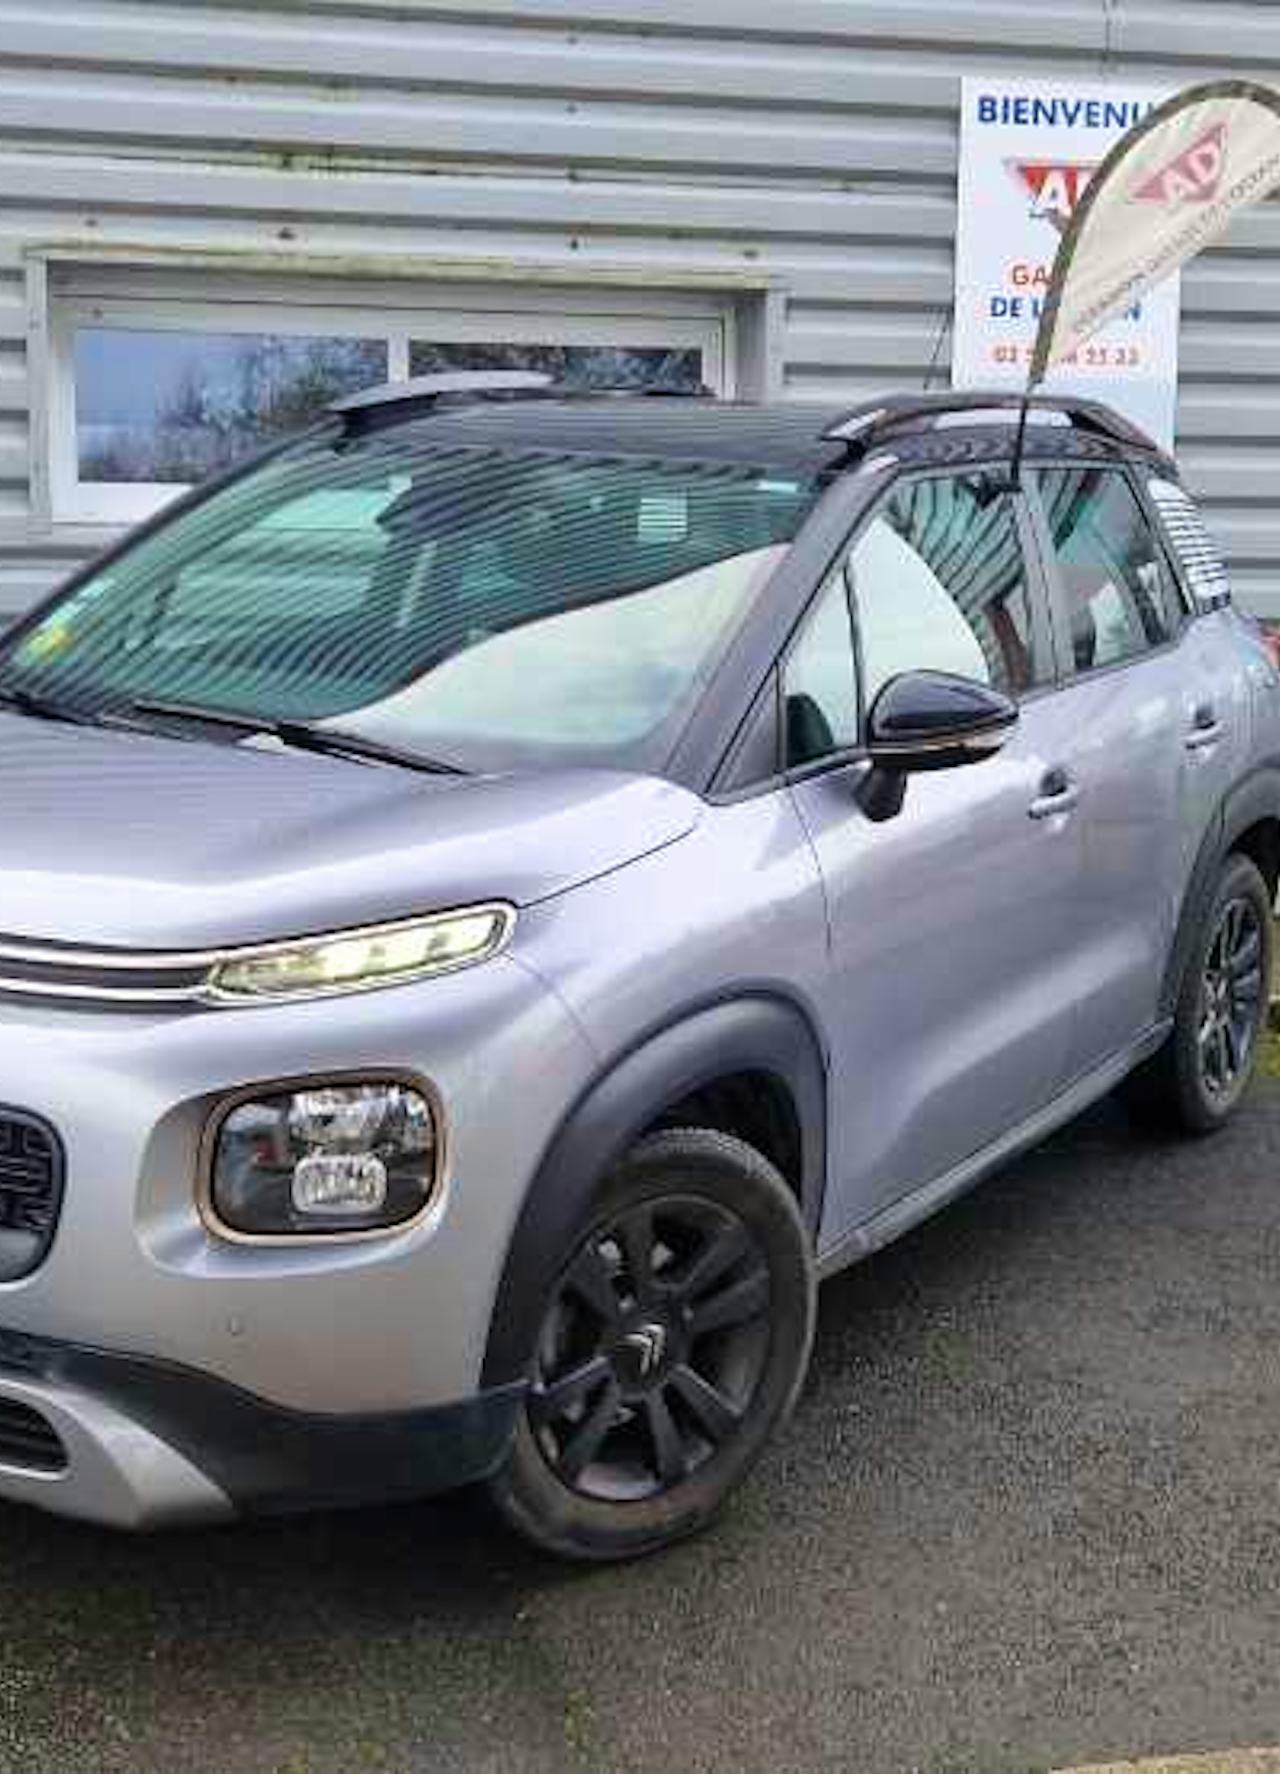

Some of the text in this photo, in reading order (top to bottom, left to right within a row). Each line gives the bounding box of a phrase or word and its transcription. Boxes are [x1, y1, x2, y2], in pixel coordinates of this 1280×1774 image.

[977, 95, 1156, 128] BIENVENU
[1160, 145, 1221, 200] AD
[990, 297, 1021, 318] DE
